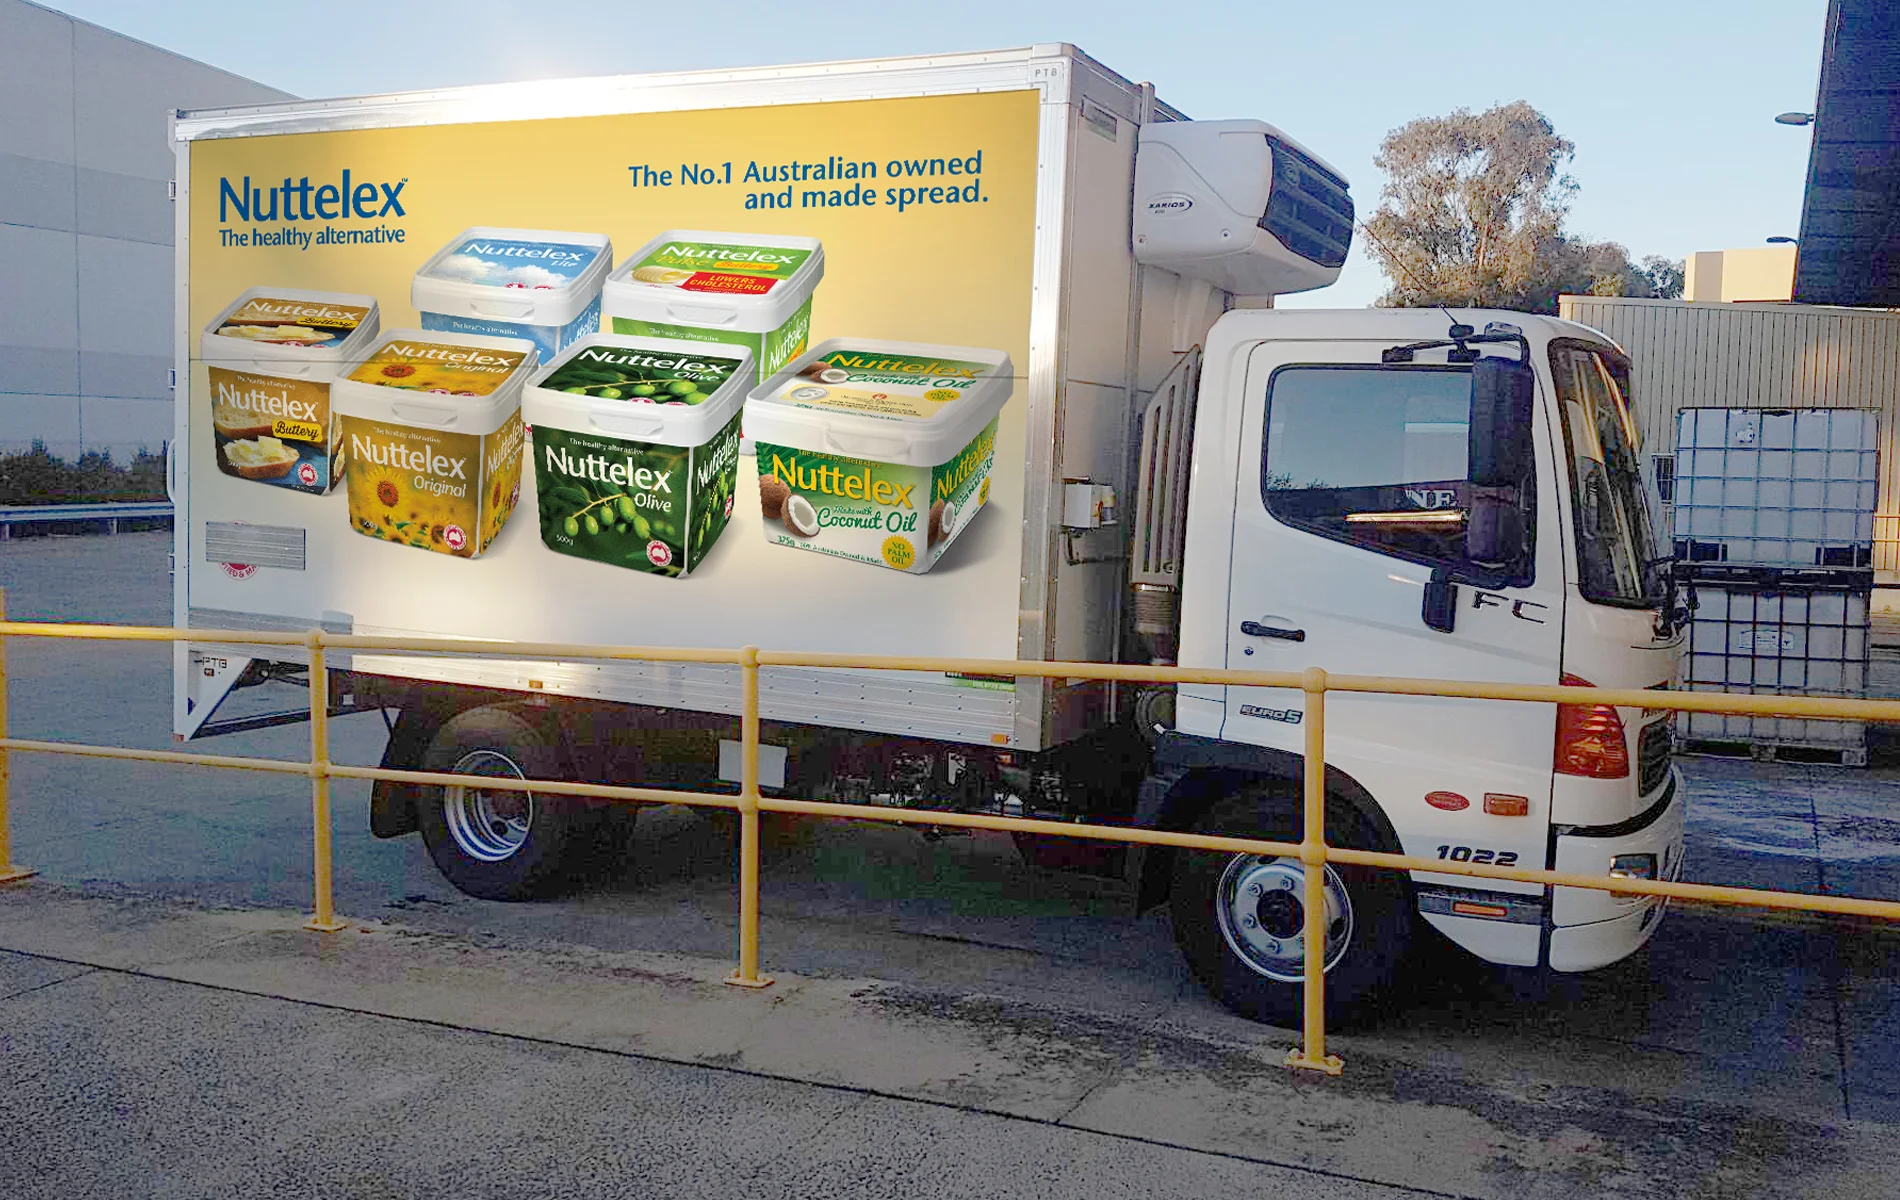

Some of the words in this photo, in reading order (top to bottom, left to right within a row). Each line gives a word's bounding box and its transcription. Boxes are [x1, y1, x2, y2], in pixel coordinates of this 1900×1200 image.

[629, 165, 673, 188] The
[681, 162, 732, 185] No.1
[743, 156, 877, 183] Australian
[886, 150, 982, 177] owned
[219, 169, 407, 222] Nuttelex
[744, 185, 793, 210] and
[802, 183, 877, 208] made
[885, 179, 989, 212] spread.
[219, 229, 249, 247] The
[252, 227, 313, 251] healthy
[316, 225, 406, 245] alternative
[465, 243, 584, 261] Nuttelex
[662, 245, 797, 264] Nuttelex
[689, 279, 767, 292] CHOLESTEROL
[710, 275, 757, 285] LOWERS
[244, 301, 360, 321] Nuttelex
[382, 344, 515, 367] Nuttelex
[578, 350, 729, 374] Nuttelex
[827, 354, 985, 379] Nuttelex
[445, 361, 509, 374] Original
[674, 371, 720, 381] Olive
[846, 373, 931, 386] Coconut
[933, 378, 977, 389] Oil
[218, 382, 318, 422] Nuttelex
[275, 420, 319, 440] Buttery
[351, 433, 467, 480] Nuttelex
[545, 445, 672, 494] Nuttelex
[414, 475, 466, 498] Original
[772, 454, 917, 509] Nuttelex
[634, 493, 672, 512] Olive
[817, 507, 883, 530] Coconut
[886, 511, 918, 532] Oil
[887, 548, 911, 558] PALM
[891, 541, 905, 550] NO
[1436, 845, 1519, 867] 1022
